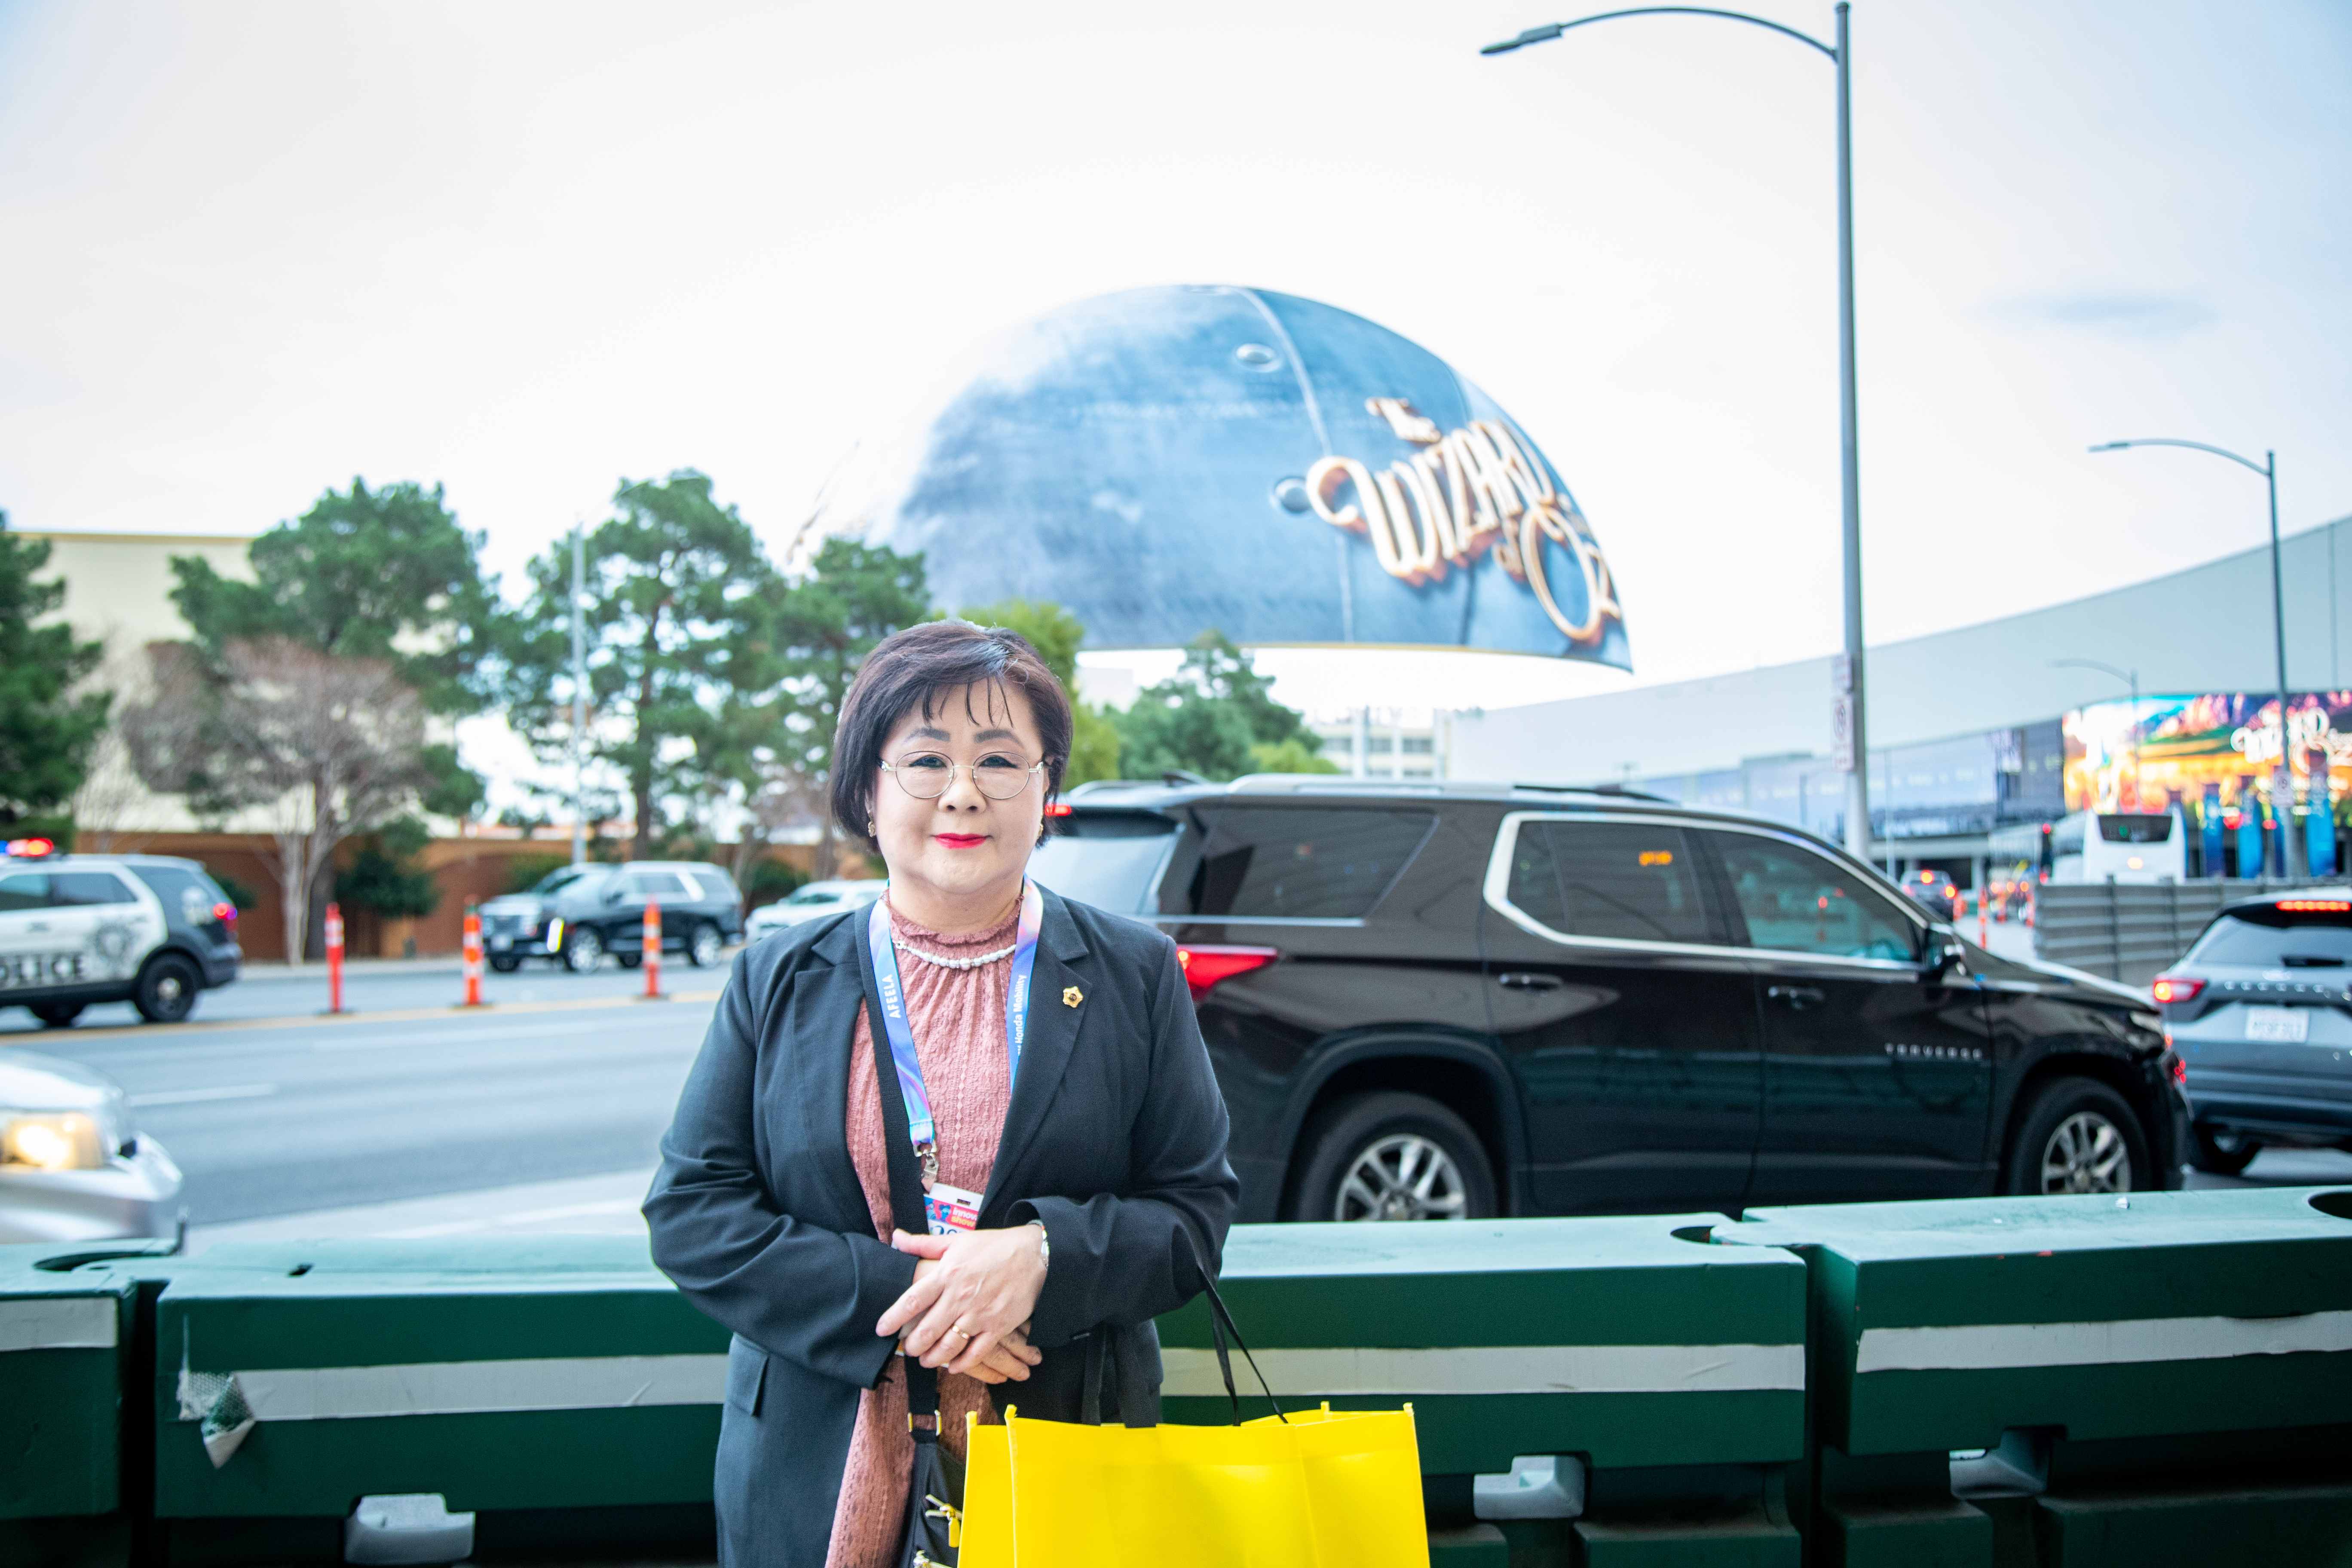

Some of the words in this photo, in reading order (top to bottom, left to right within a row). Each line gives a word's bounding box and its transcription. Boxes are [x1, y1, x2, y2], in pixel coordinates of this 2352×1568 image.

[1306, 417, 1556, 578] WIZARD
[882, 974, 901, 1018] AFEELA
[1013, 974, 1027, 1012] Mobility
[1013, 1014, 1024, 1044] Honda
[951, 1216, 976, 1227] show
